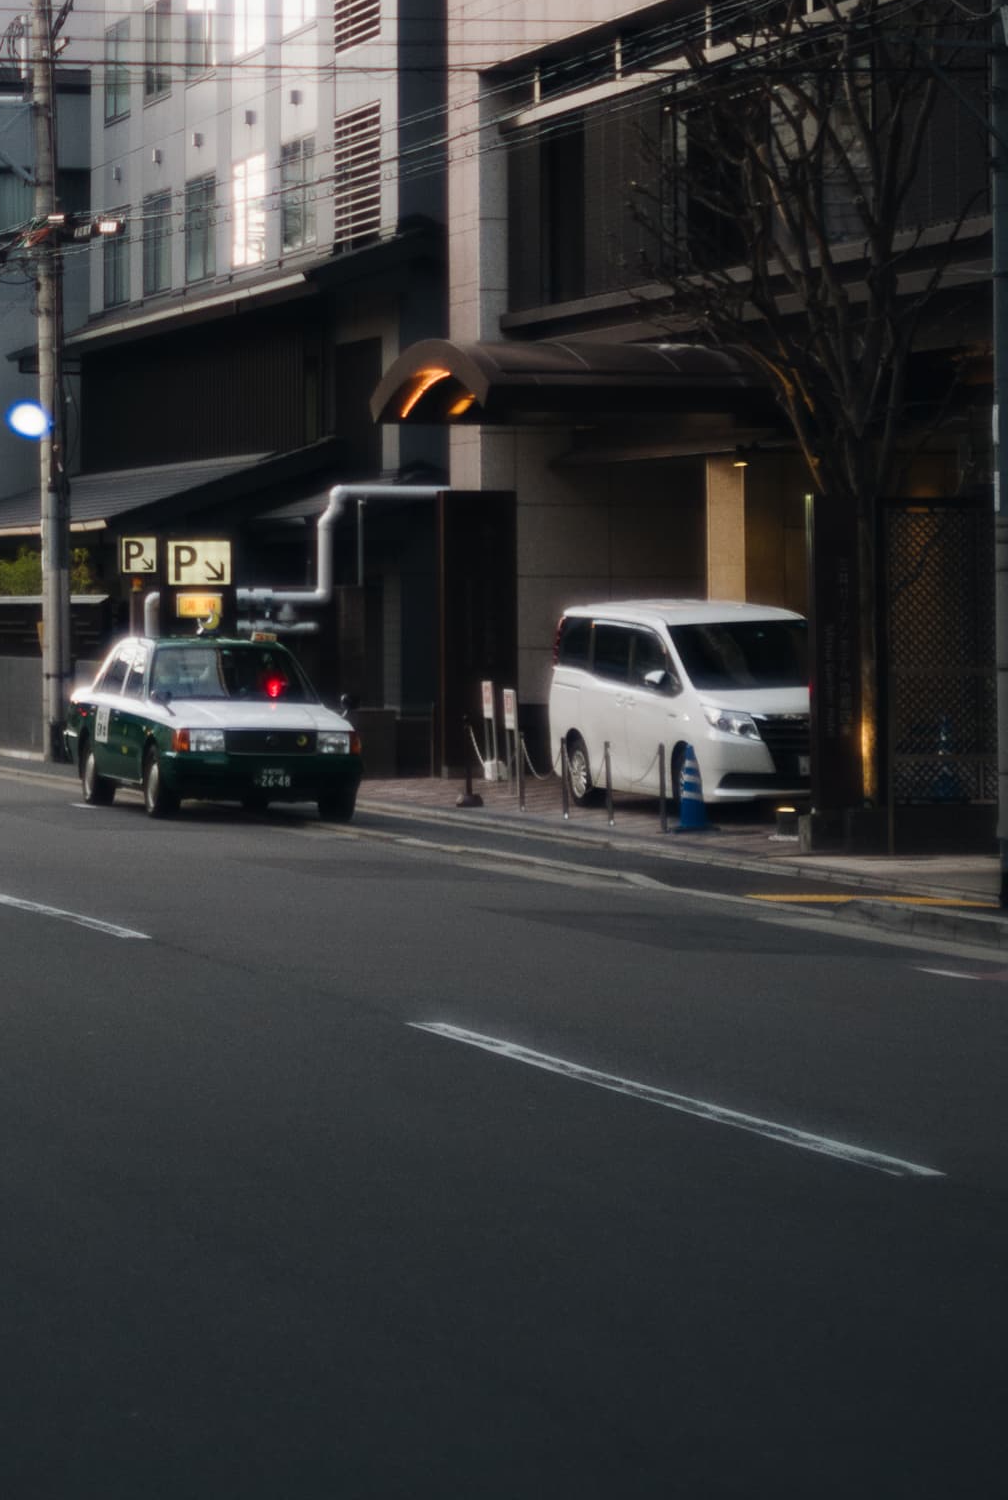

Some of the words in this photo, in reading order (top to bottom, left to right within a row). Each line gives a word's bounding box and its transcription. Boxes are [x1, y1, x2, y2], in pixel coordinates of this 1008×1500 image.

[124, 540, 144, 571] P
[174, 545, 198, 581] P
[261, 775, 291, 787] 26-48
